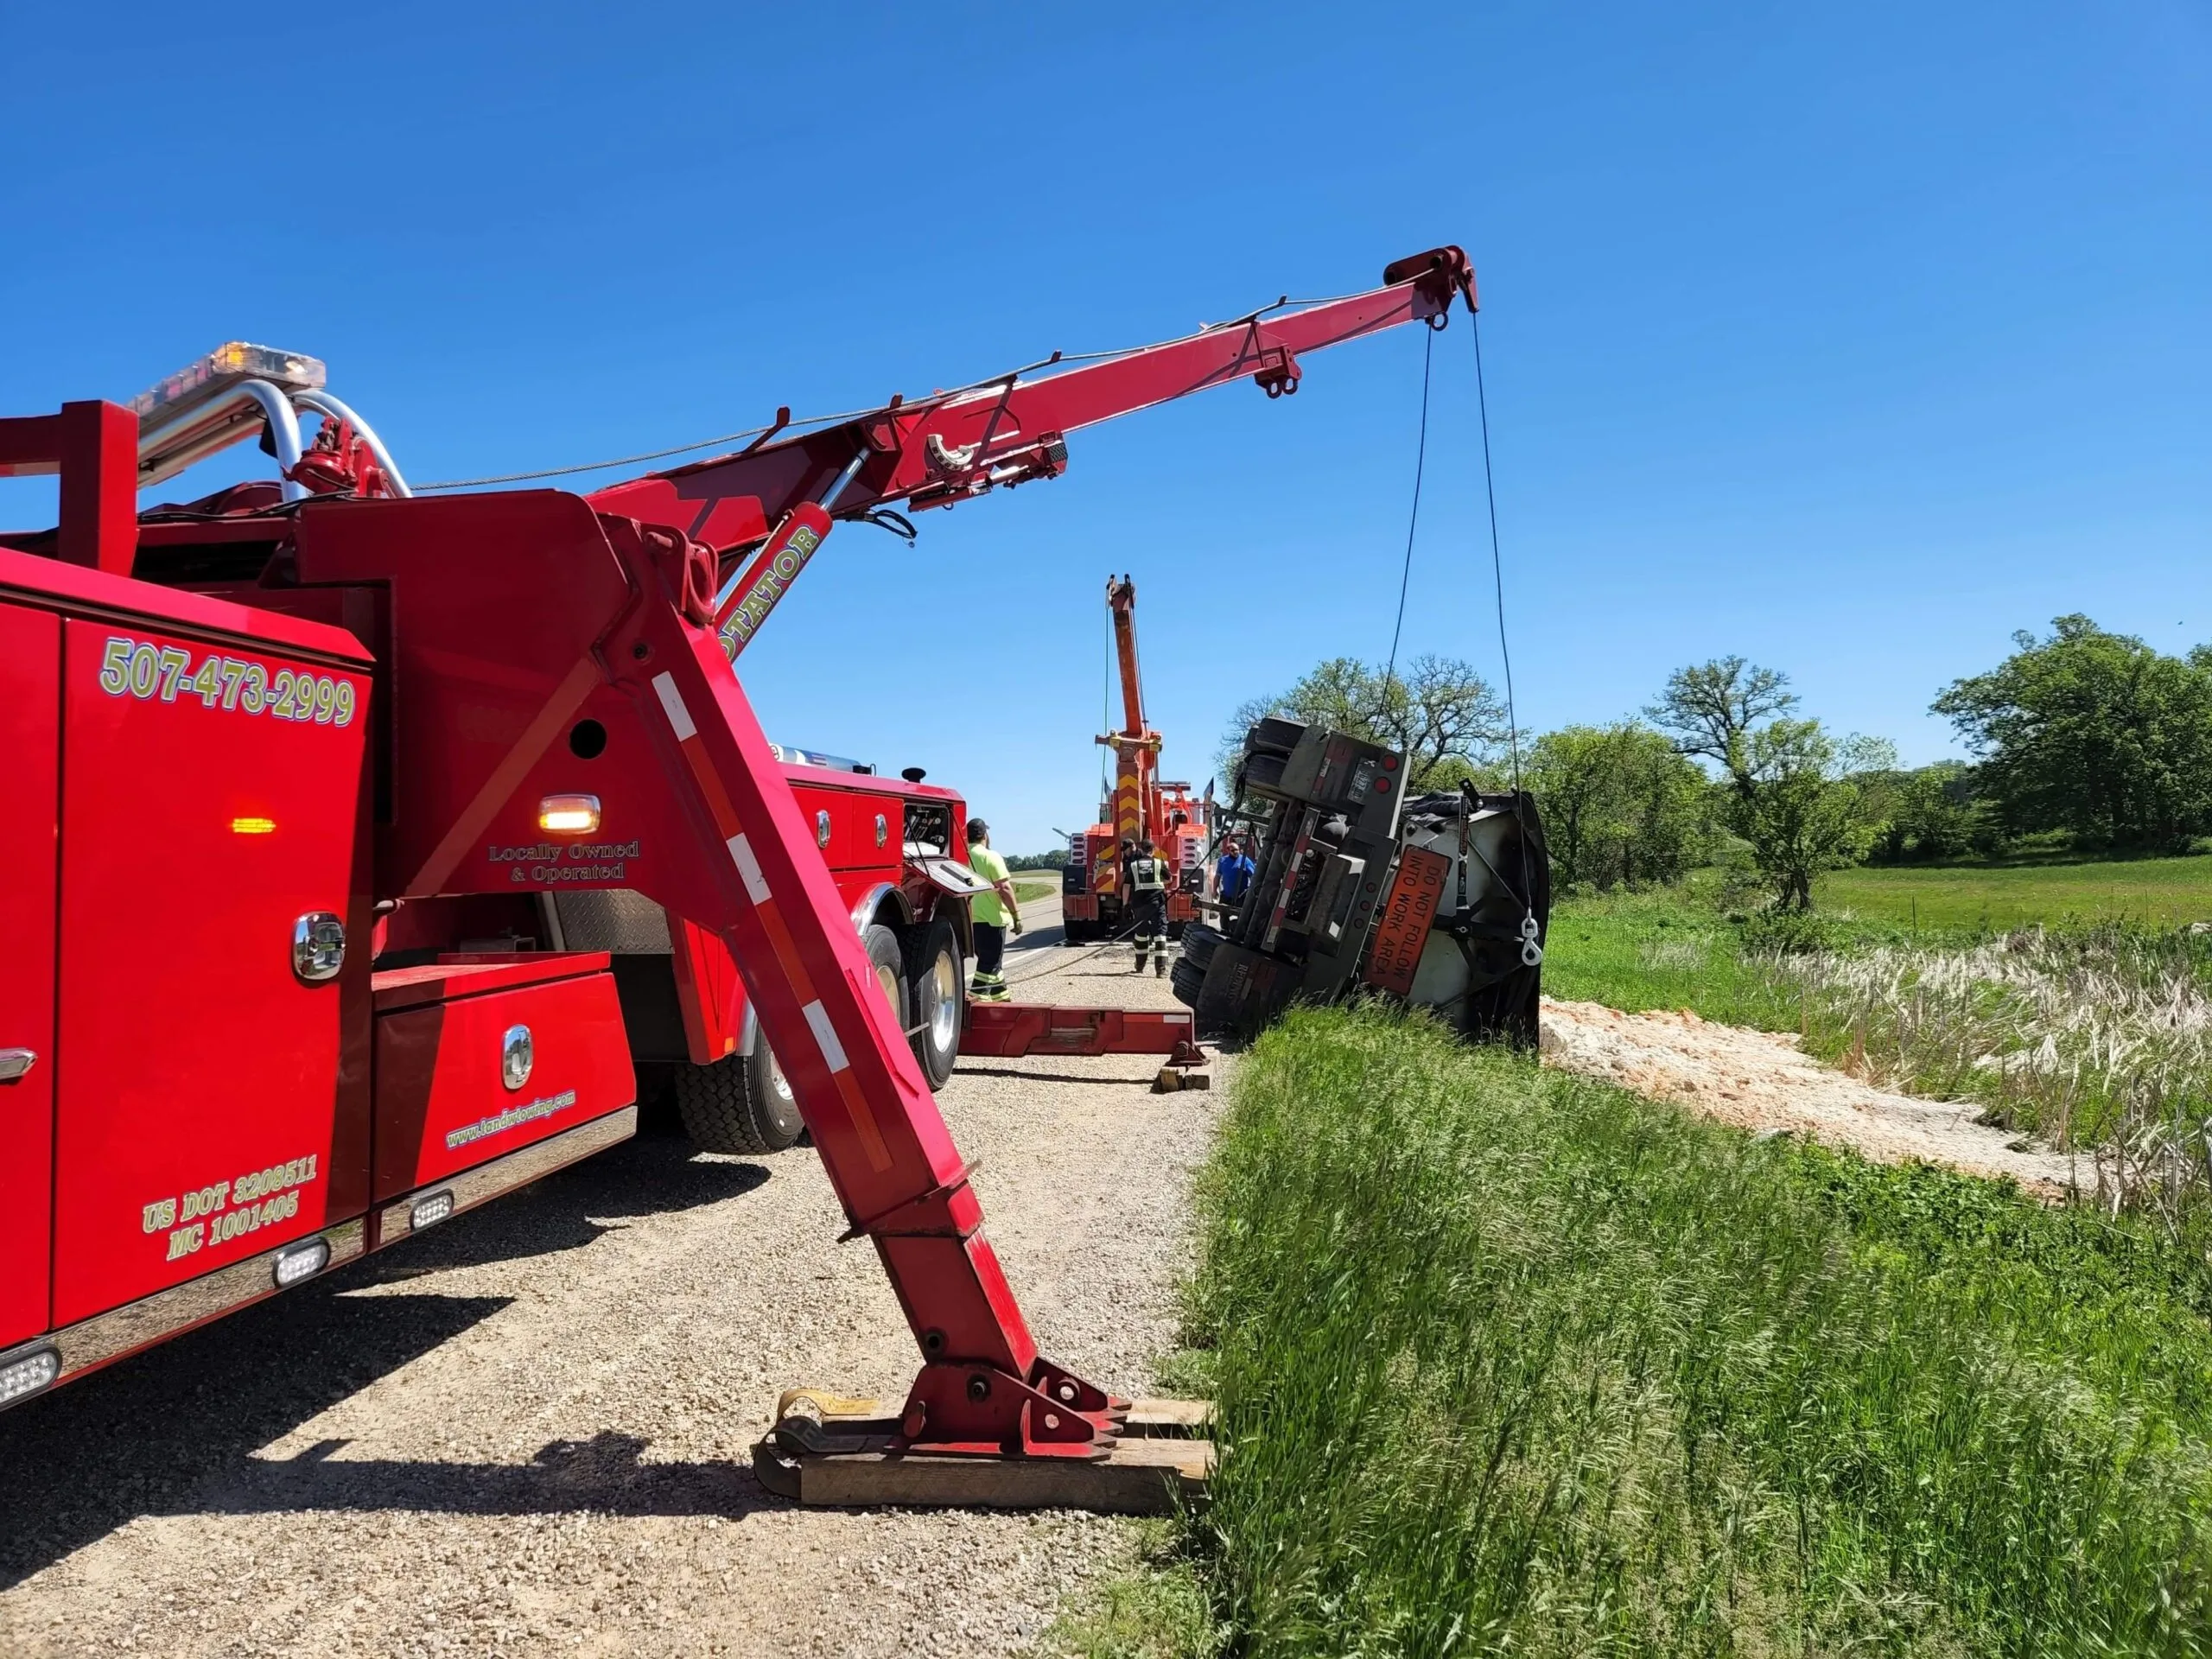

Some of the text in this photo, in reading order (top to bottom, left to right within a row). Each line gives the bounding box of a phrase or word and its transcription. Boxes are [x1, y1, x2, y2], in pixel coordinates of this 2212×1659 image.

[99, 637, 356, 728] 507-473-2999
[489, 841, 639, 862] Locally Owned
[511, 862, 625, 884] & Operated
[1372, 855, 1424, 975] INTO WORK AREA
[1393, 865, 1440, 979] DO NOT FOLLOW
[143, 1154, 317, 1234] US DOT 3208511
[167, 1190, 300, 1262] MC 1001405
